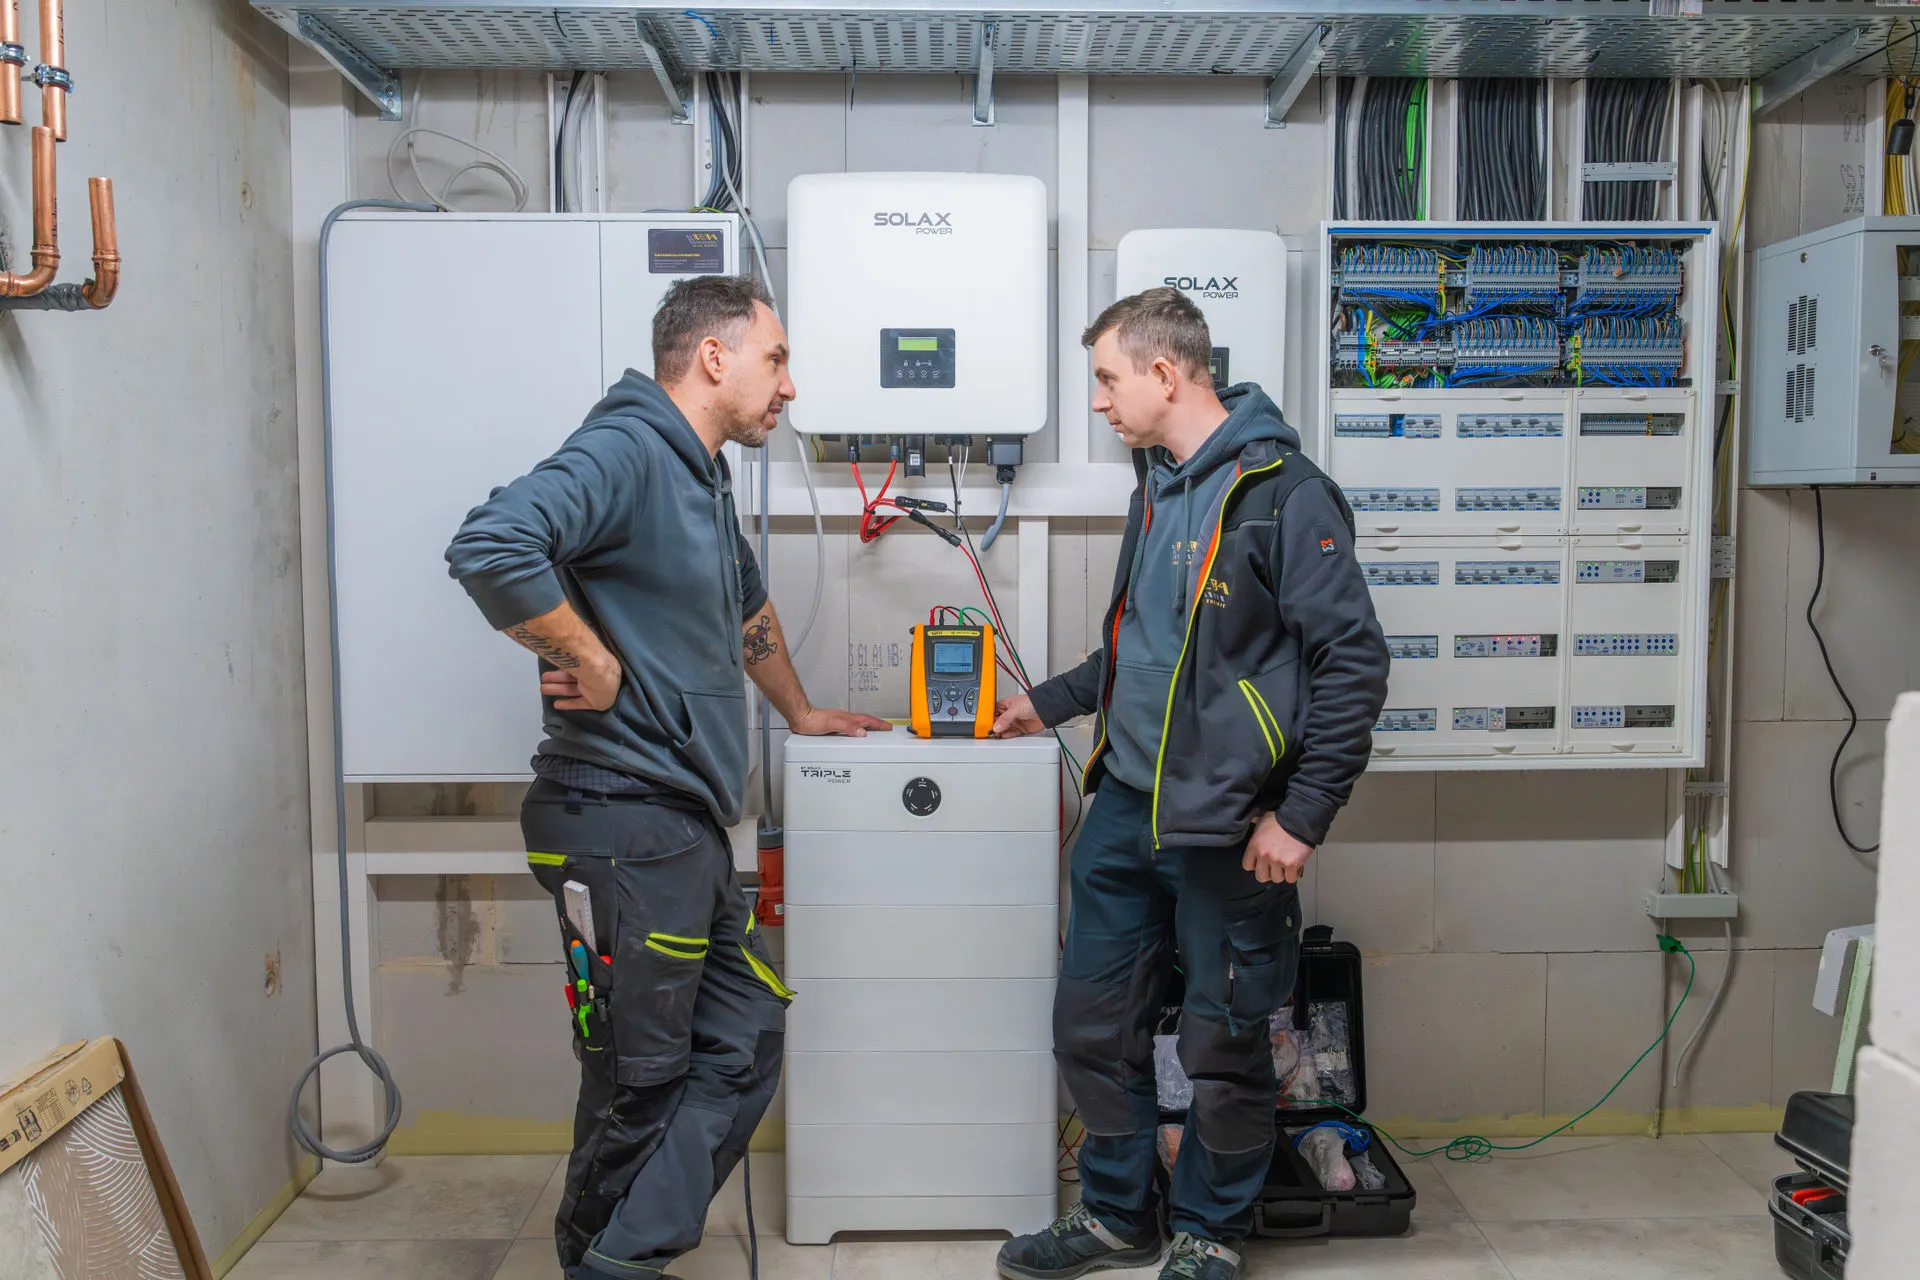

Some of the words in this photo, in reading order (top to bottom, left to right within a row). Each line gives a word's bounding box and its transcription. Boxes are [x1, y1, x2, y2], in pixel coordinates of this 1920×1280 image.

[874, 212, 952, 226] SOLAX
[915, 227, 953, 235] POWER
[1163, 276, 1239, 291] SOLAX
[1202, 291, 1239, 299] POWER
[800, 770, 851, 778] TRIPLE
